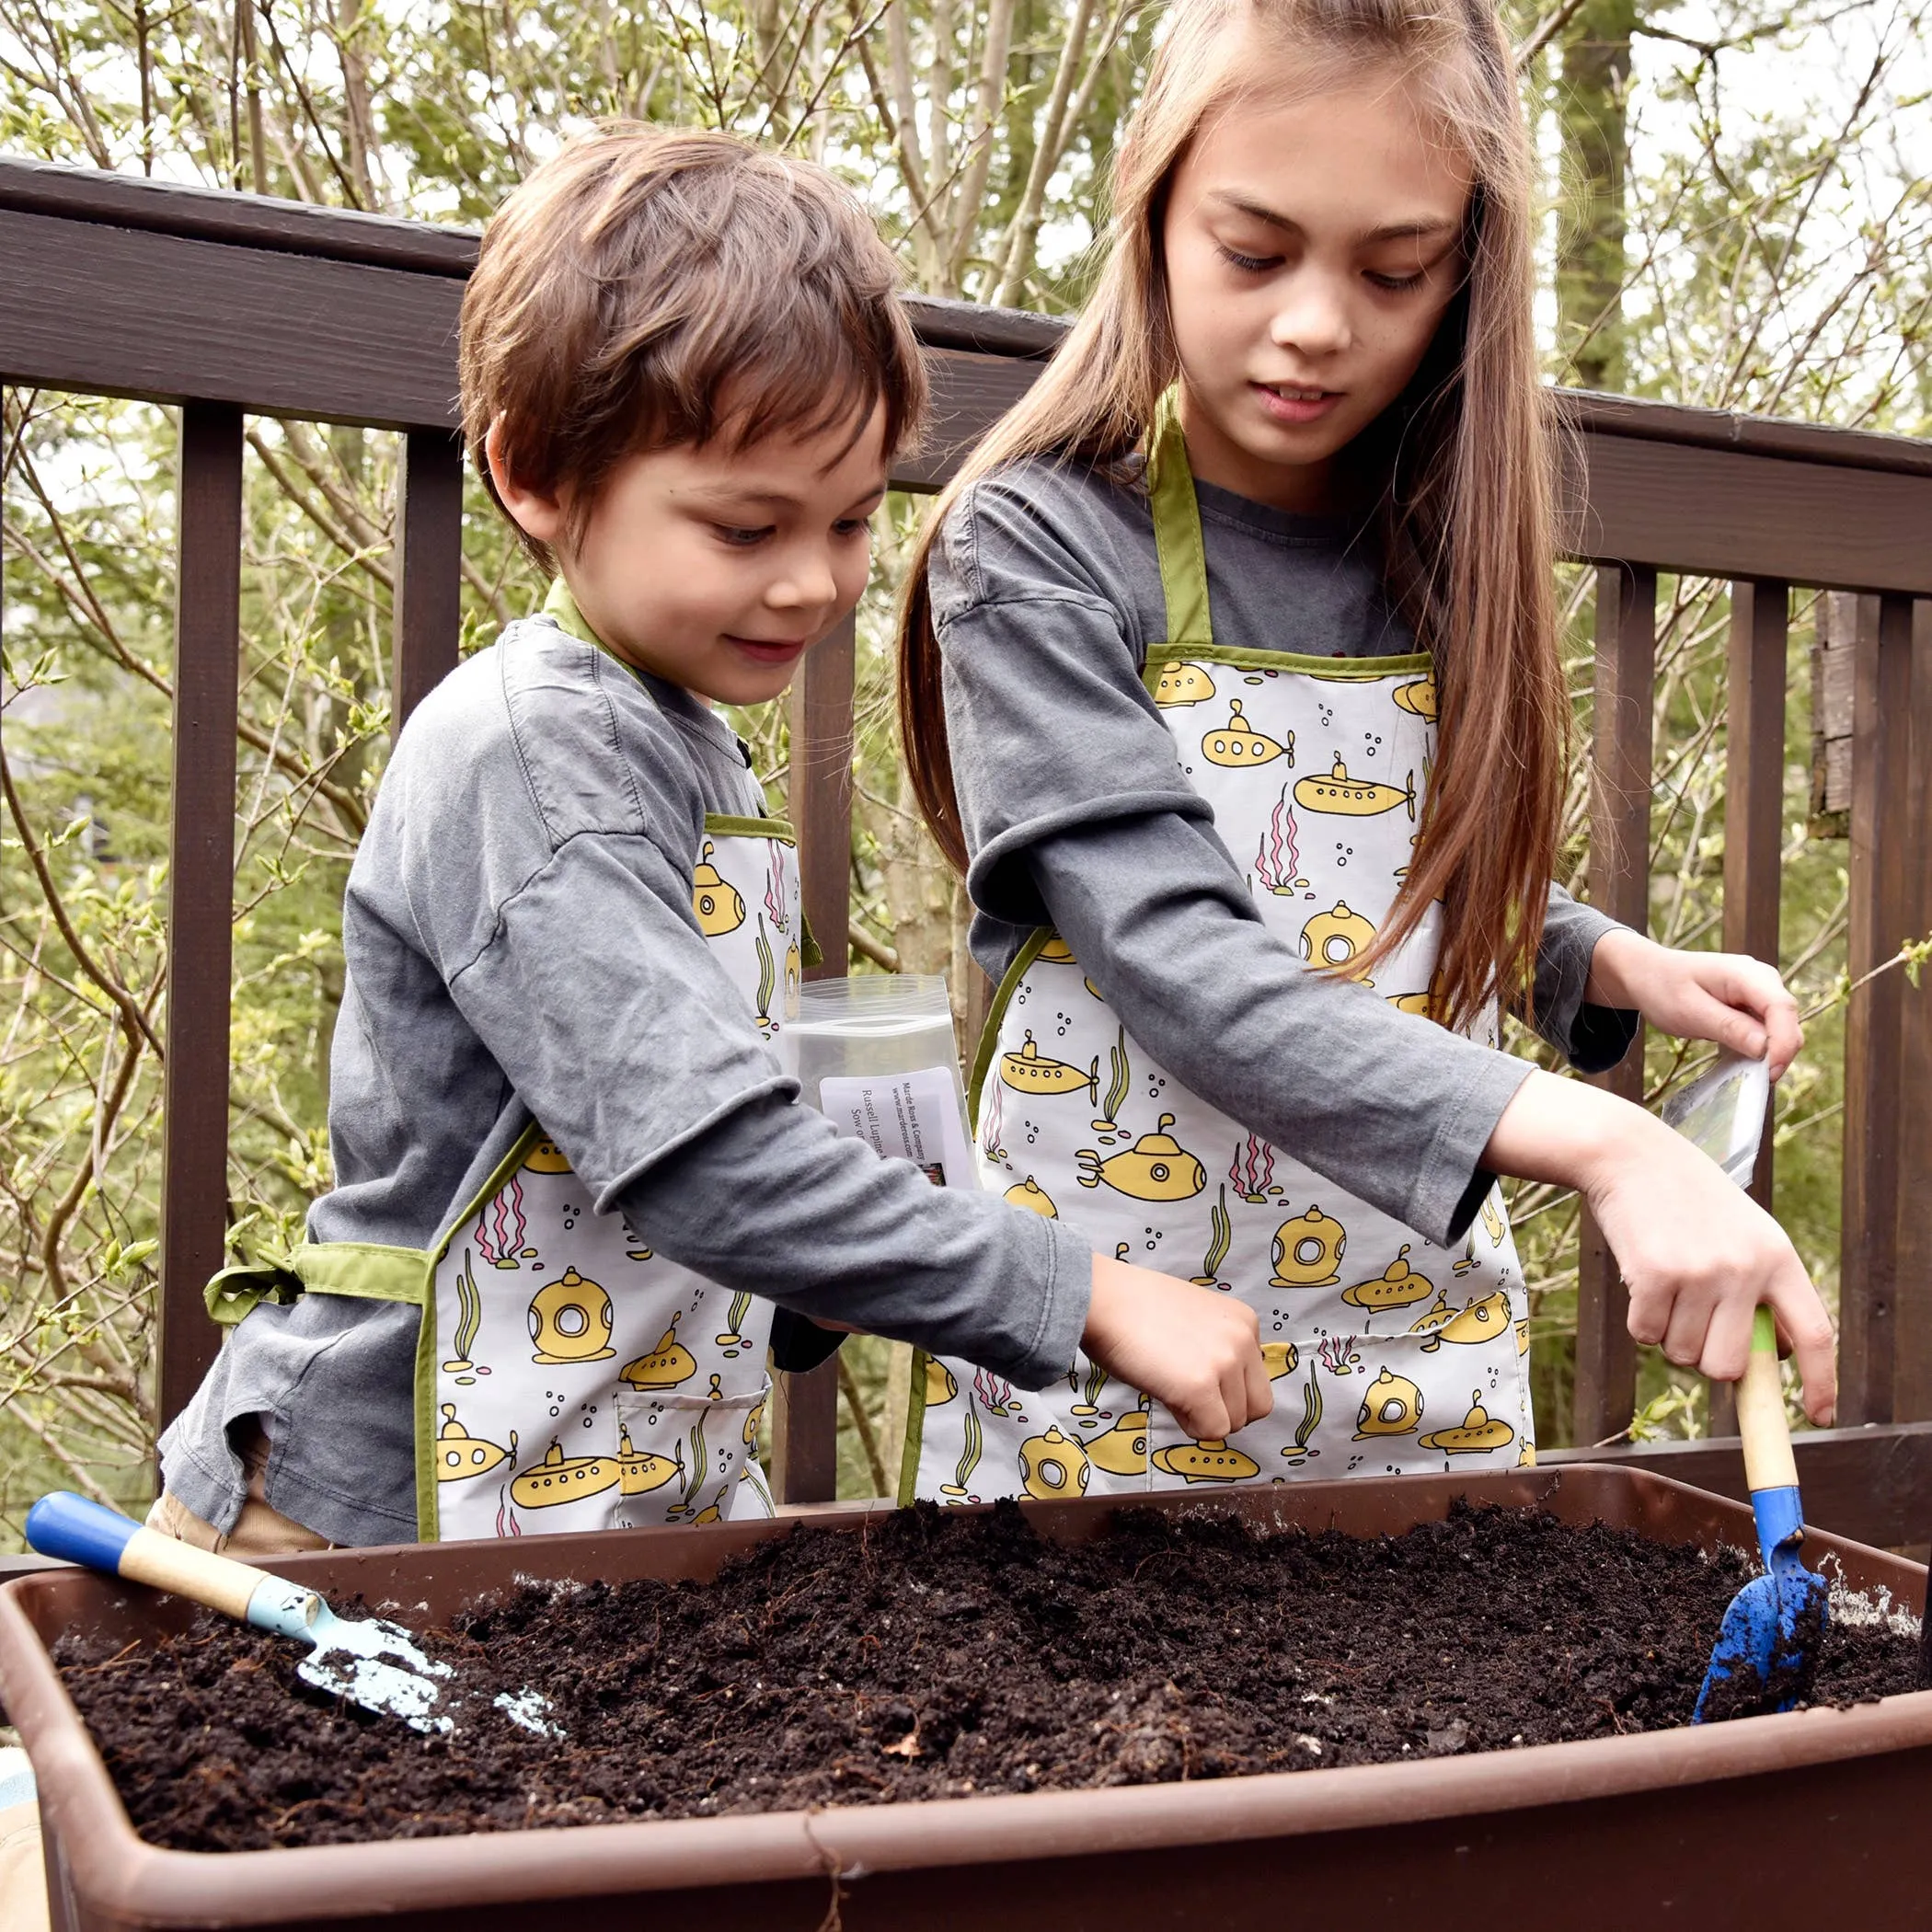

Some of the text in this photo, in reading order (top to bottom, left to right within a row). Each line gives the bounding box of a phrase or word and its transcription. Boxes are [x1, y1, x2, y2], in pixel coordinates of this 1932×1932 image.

[903, 1082, 914, 1104] Marde
[851, 1109, 862, 1128] Sow
[862, 1090, 883, 1154] Russell Lupine
[892, 1087, 913, 1157] www.mardeross.com
[907, 1106, 916, 1121] Ross
[913, 1130, 925, 1160] Company
